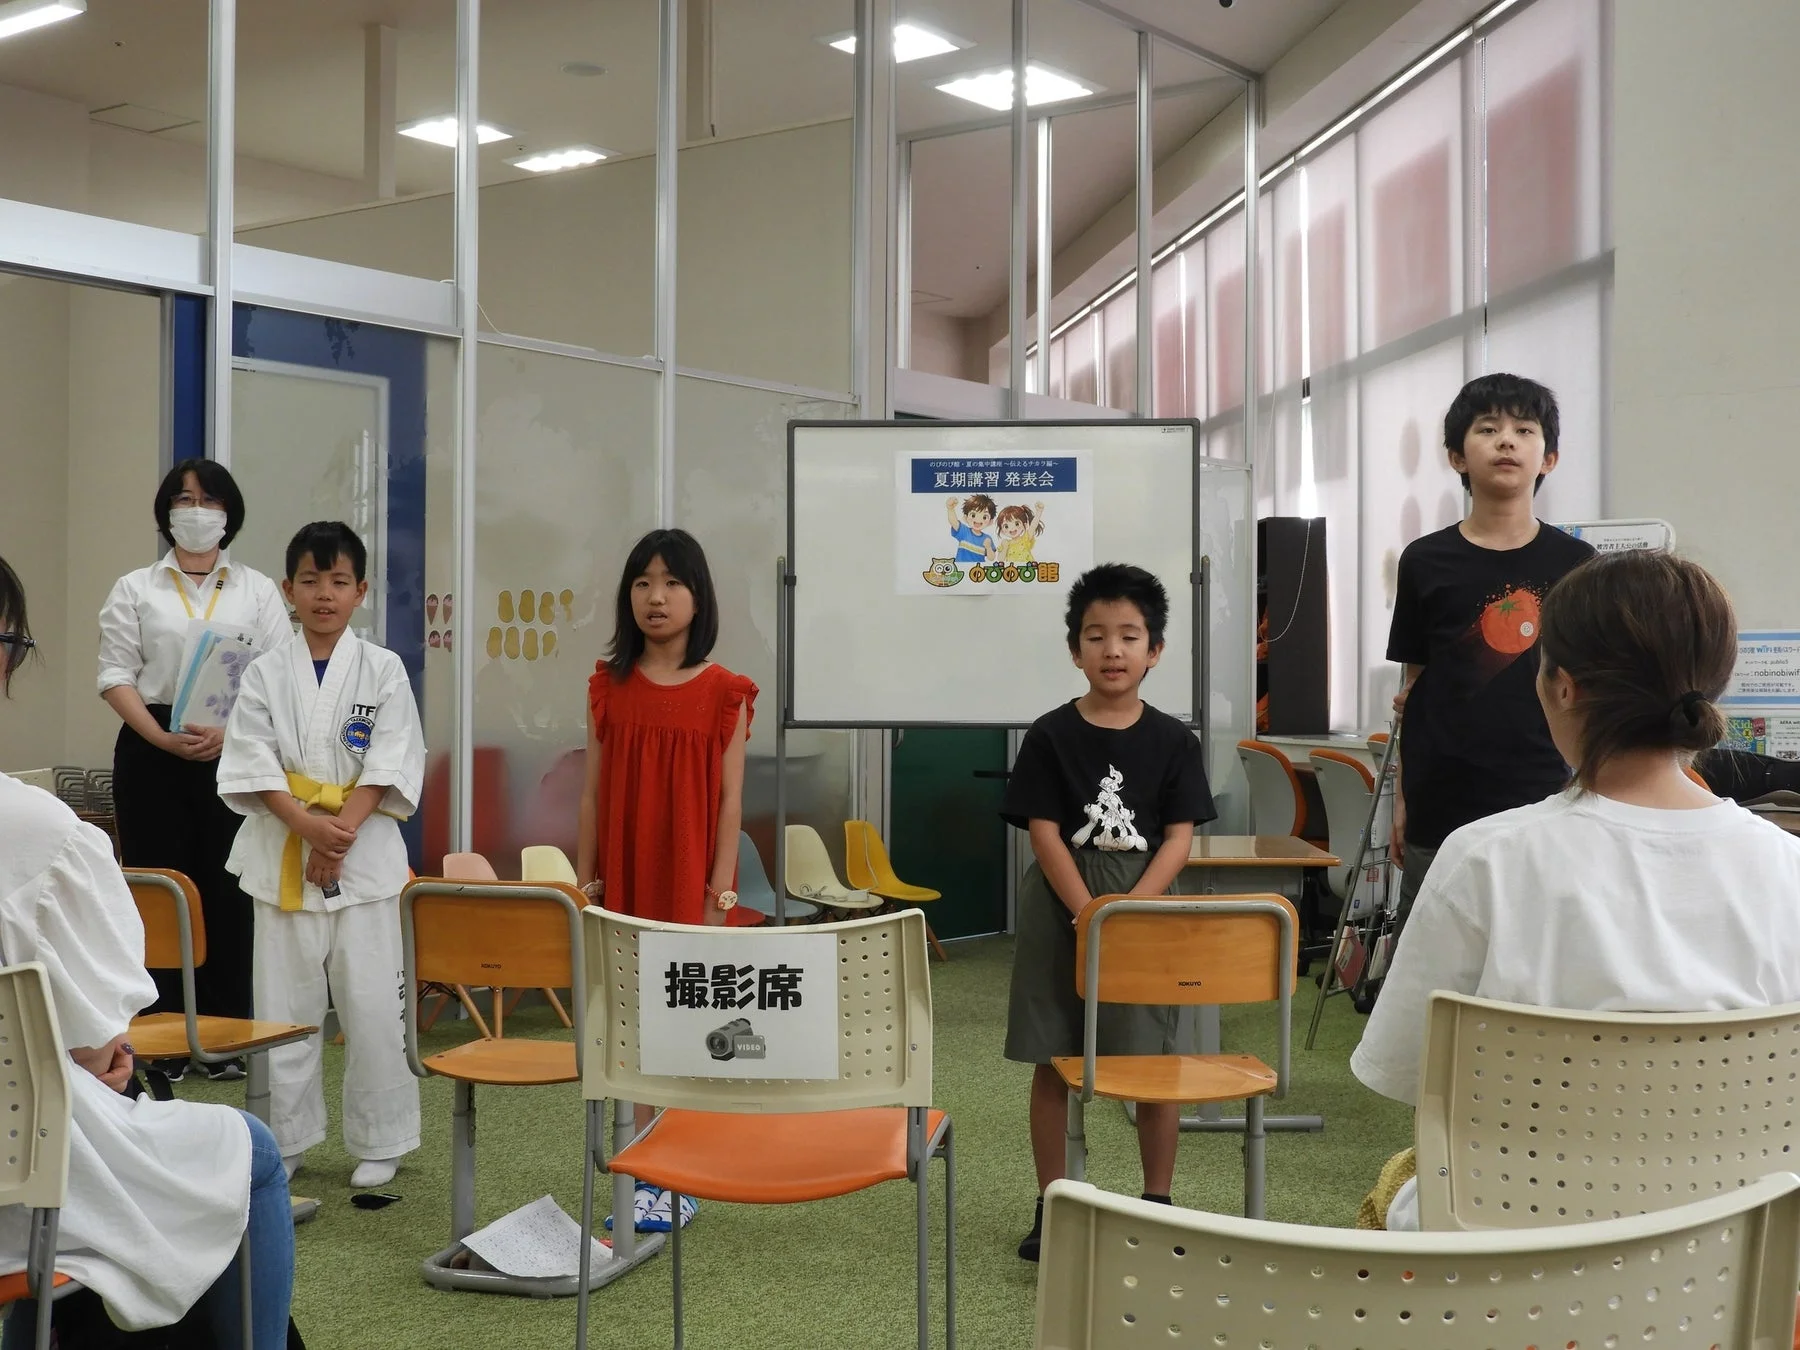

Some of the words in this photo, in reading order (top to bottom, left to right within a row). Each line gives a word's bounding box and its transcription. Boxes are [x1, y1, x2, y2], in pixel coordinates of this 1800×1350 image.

[933, 471, 1000, 488] 夏期講習
[1004, 470, 1055, 488] 発表会
[969, 561, 1060, 583] のびのび館
[352, 704, 376, 716] ITF
[664, 961, 804, 1011] 撮影席
[736, 1043, 761, 1051] VIDEO
